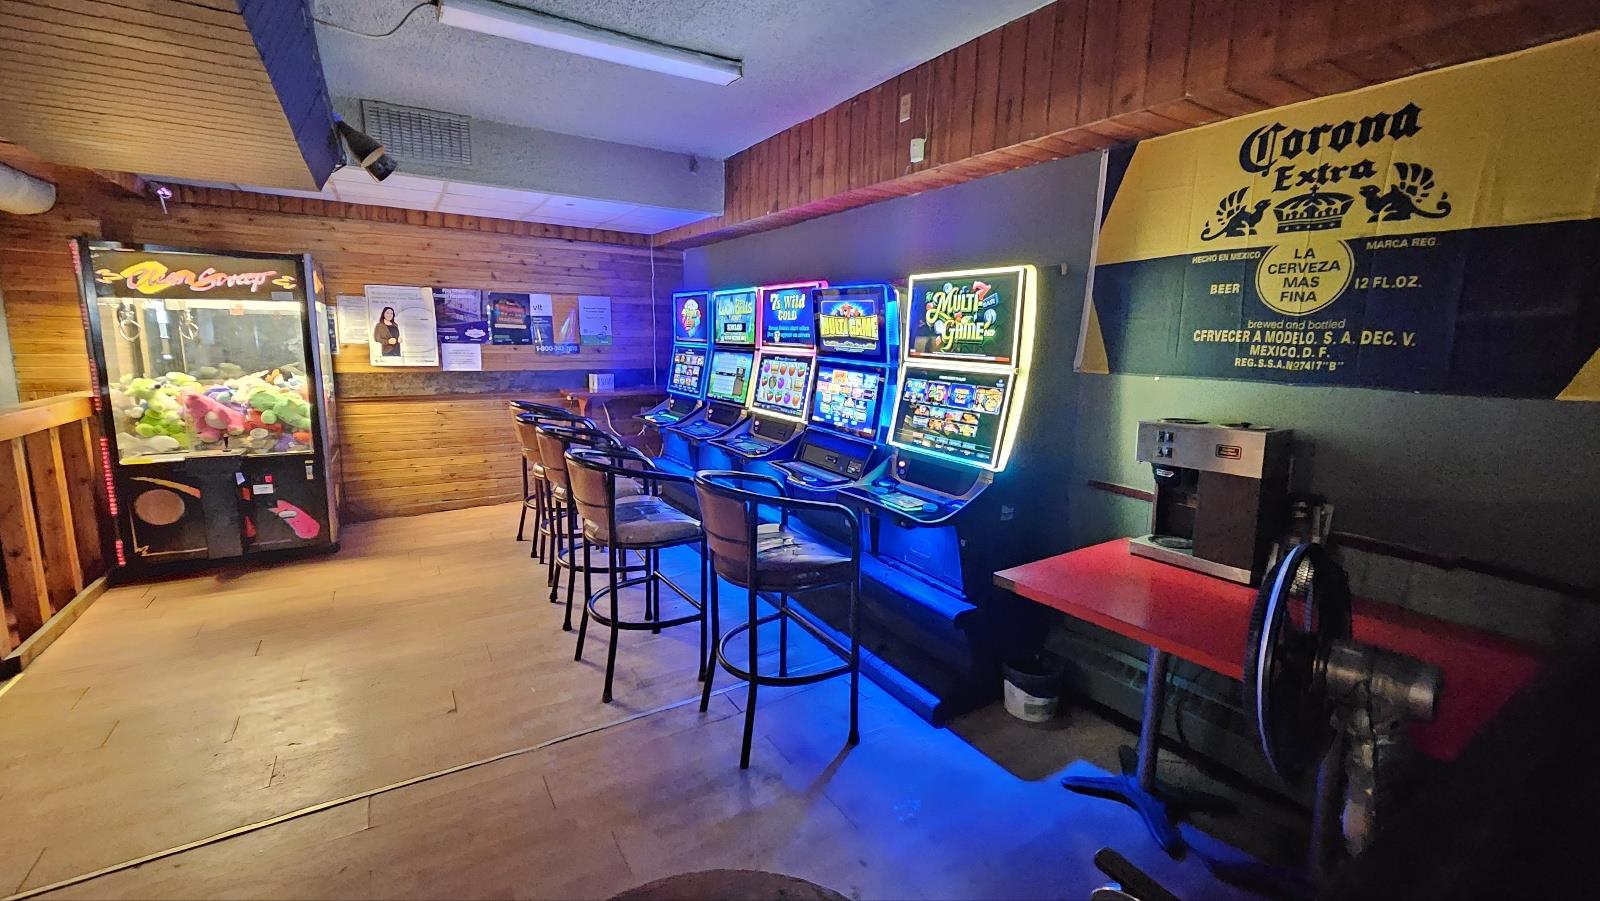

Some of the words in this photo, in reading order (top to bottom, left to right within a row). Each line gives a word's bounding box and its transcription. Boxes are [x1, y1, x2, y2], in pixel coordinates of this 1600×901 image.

[1239, 102, 1423, 177] Corona
[1272, 158, 1378, 193] Extra
[1366, 238, 1409, 250] MARCA
[1192, 254, 1217, 264] HECHO
[1218, 253, 1229, 261] EN
[1230, 251, 1261, 261] MEXICO
[1294, 248, 1316, 259] LA
[1267, 260, 1341, 275] CERVEZA
[1210, 283, 1240, 295] BEER
[1283, 276, 1320, 289] MAS
[1354, 277, 1369, 290] 12
[783, 294, 806, 309] Wild
[1280, 291, 1317, 303] FINA
[848, 316, 878, 338] GAME
[1247, 320, 1283, 329] brewed
[1285, 320, 1305, 330] and
[1307, 319, 1346, 330] bottled
[941, 319, 984, 352] GAME
[1323, 331, 1337, 345] S.
[1340, 331, 1356, 344] A.
[1402, 331, 1417, 347] V.
